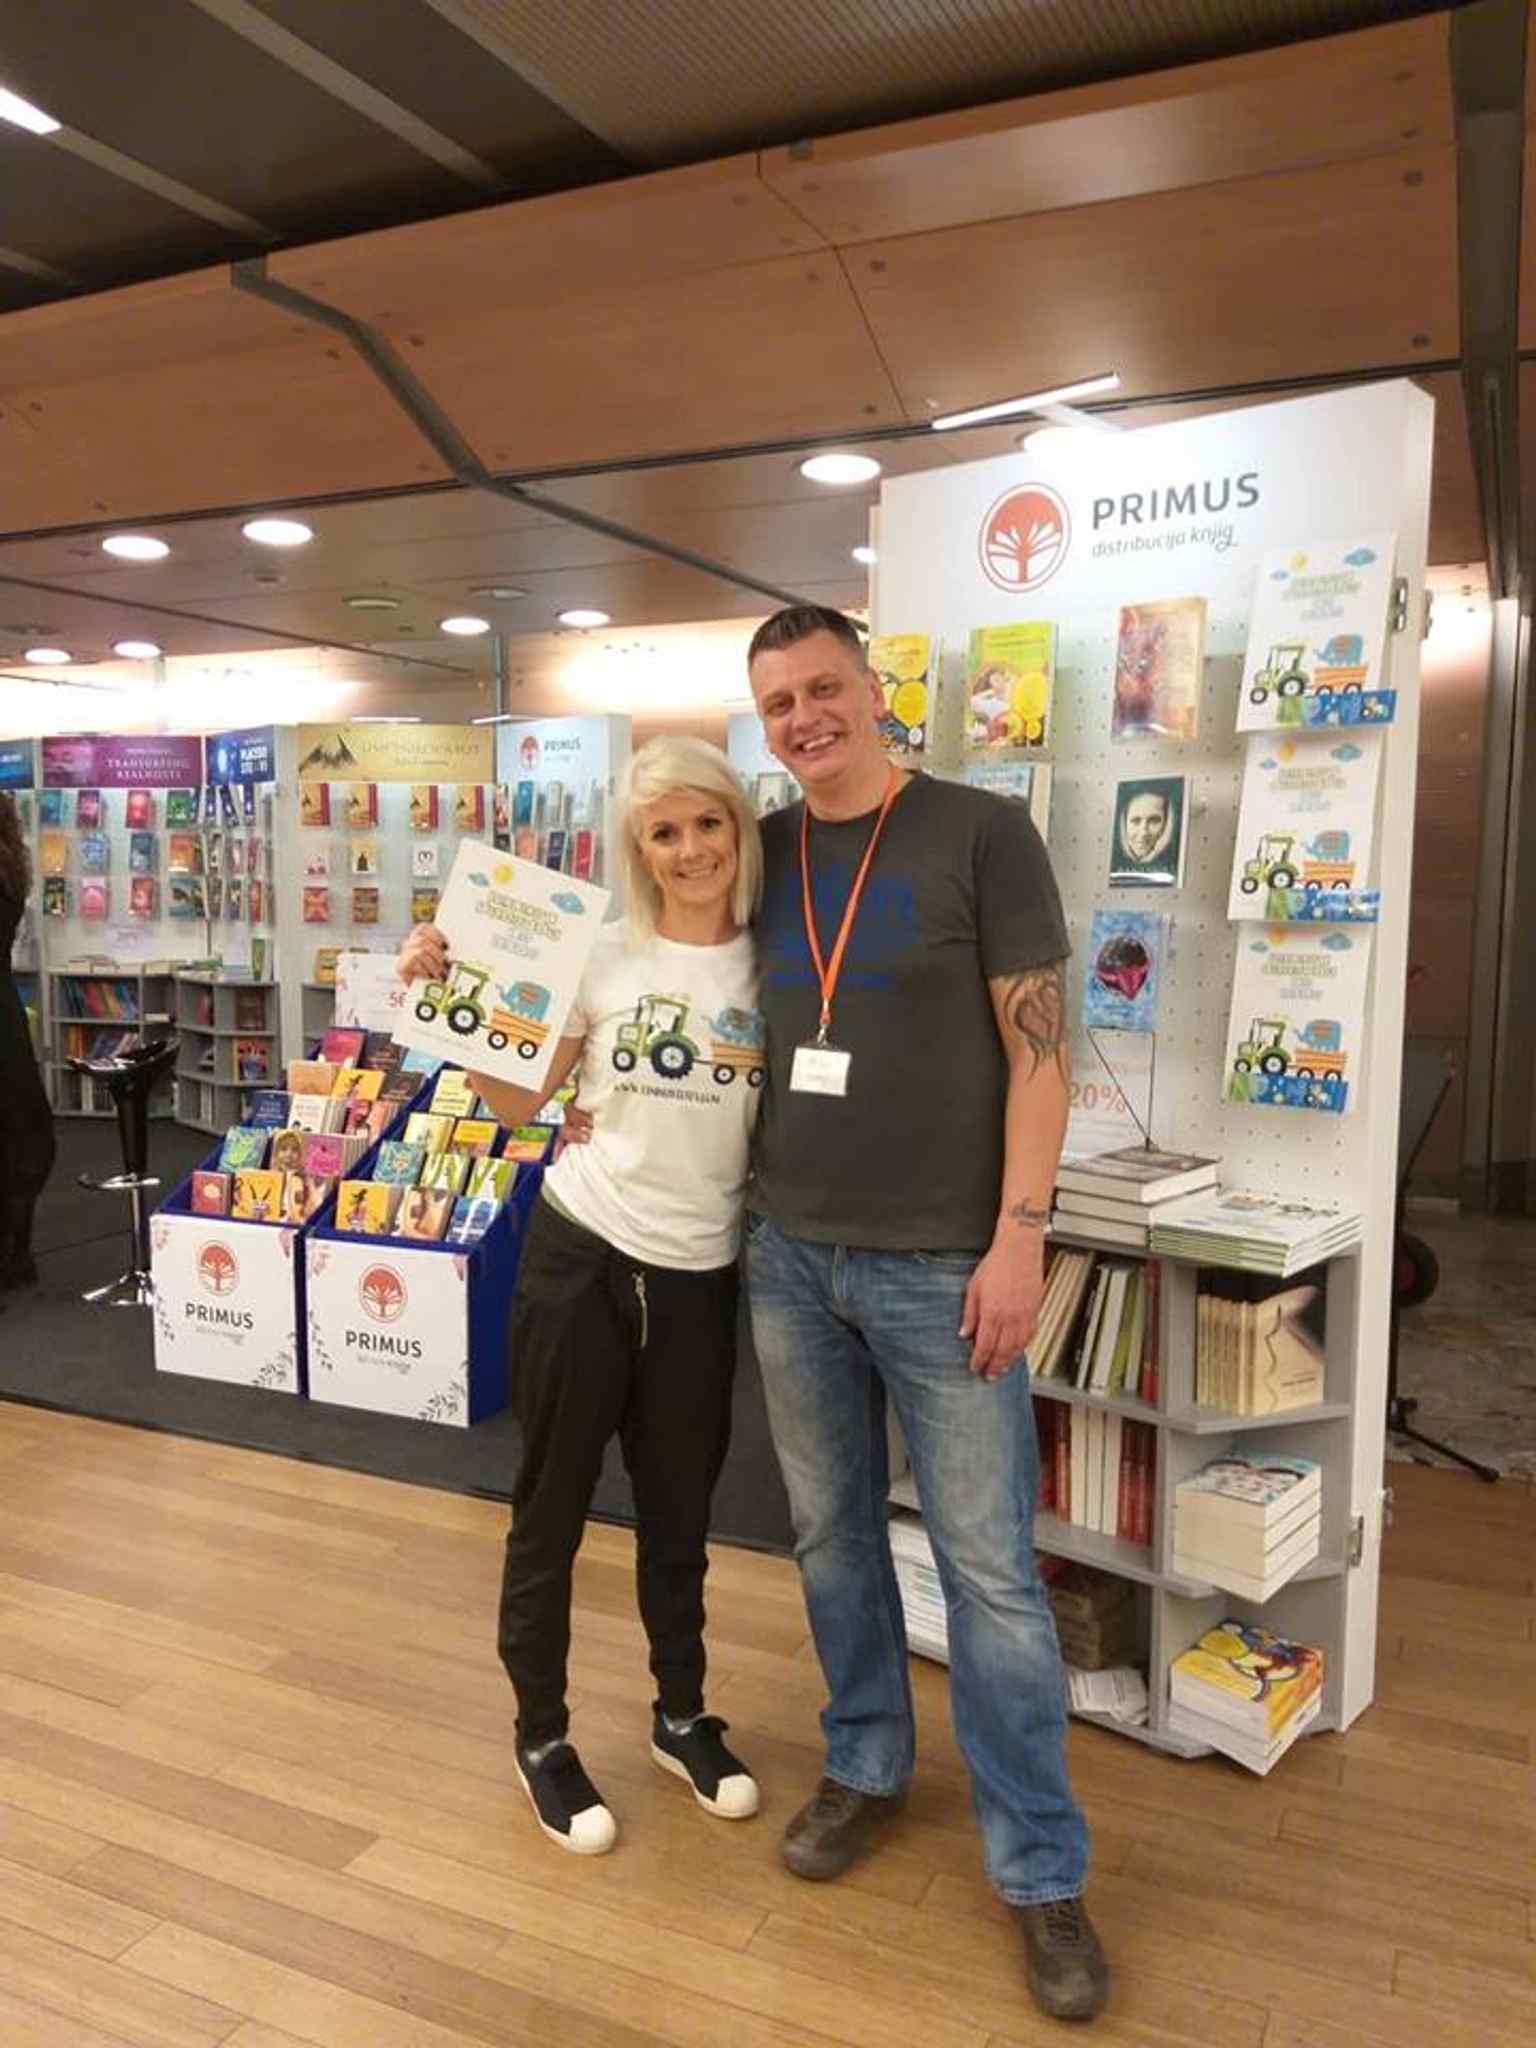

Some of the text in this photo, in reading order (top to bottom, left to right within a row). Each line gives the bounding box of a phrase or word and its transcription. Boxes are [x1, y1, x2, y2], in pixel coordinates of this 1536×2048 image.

[1092, 472, 1261, 531] PRIMUS
[1091, 520, 1239, 559] distribucija knjig
[184, 1301, 254, 1331] PRIMUS
[344, 1329, 422, 1359] PRIMUS
